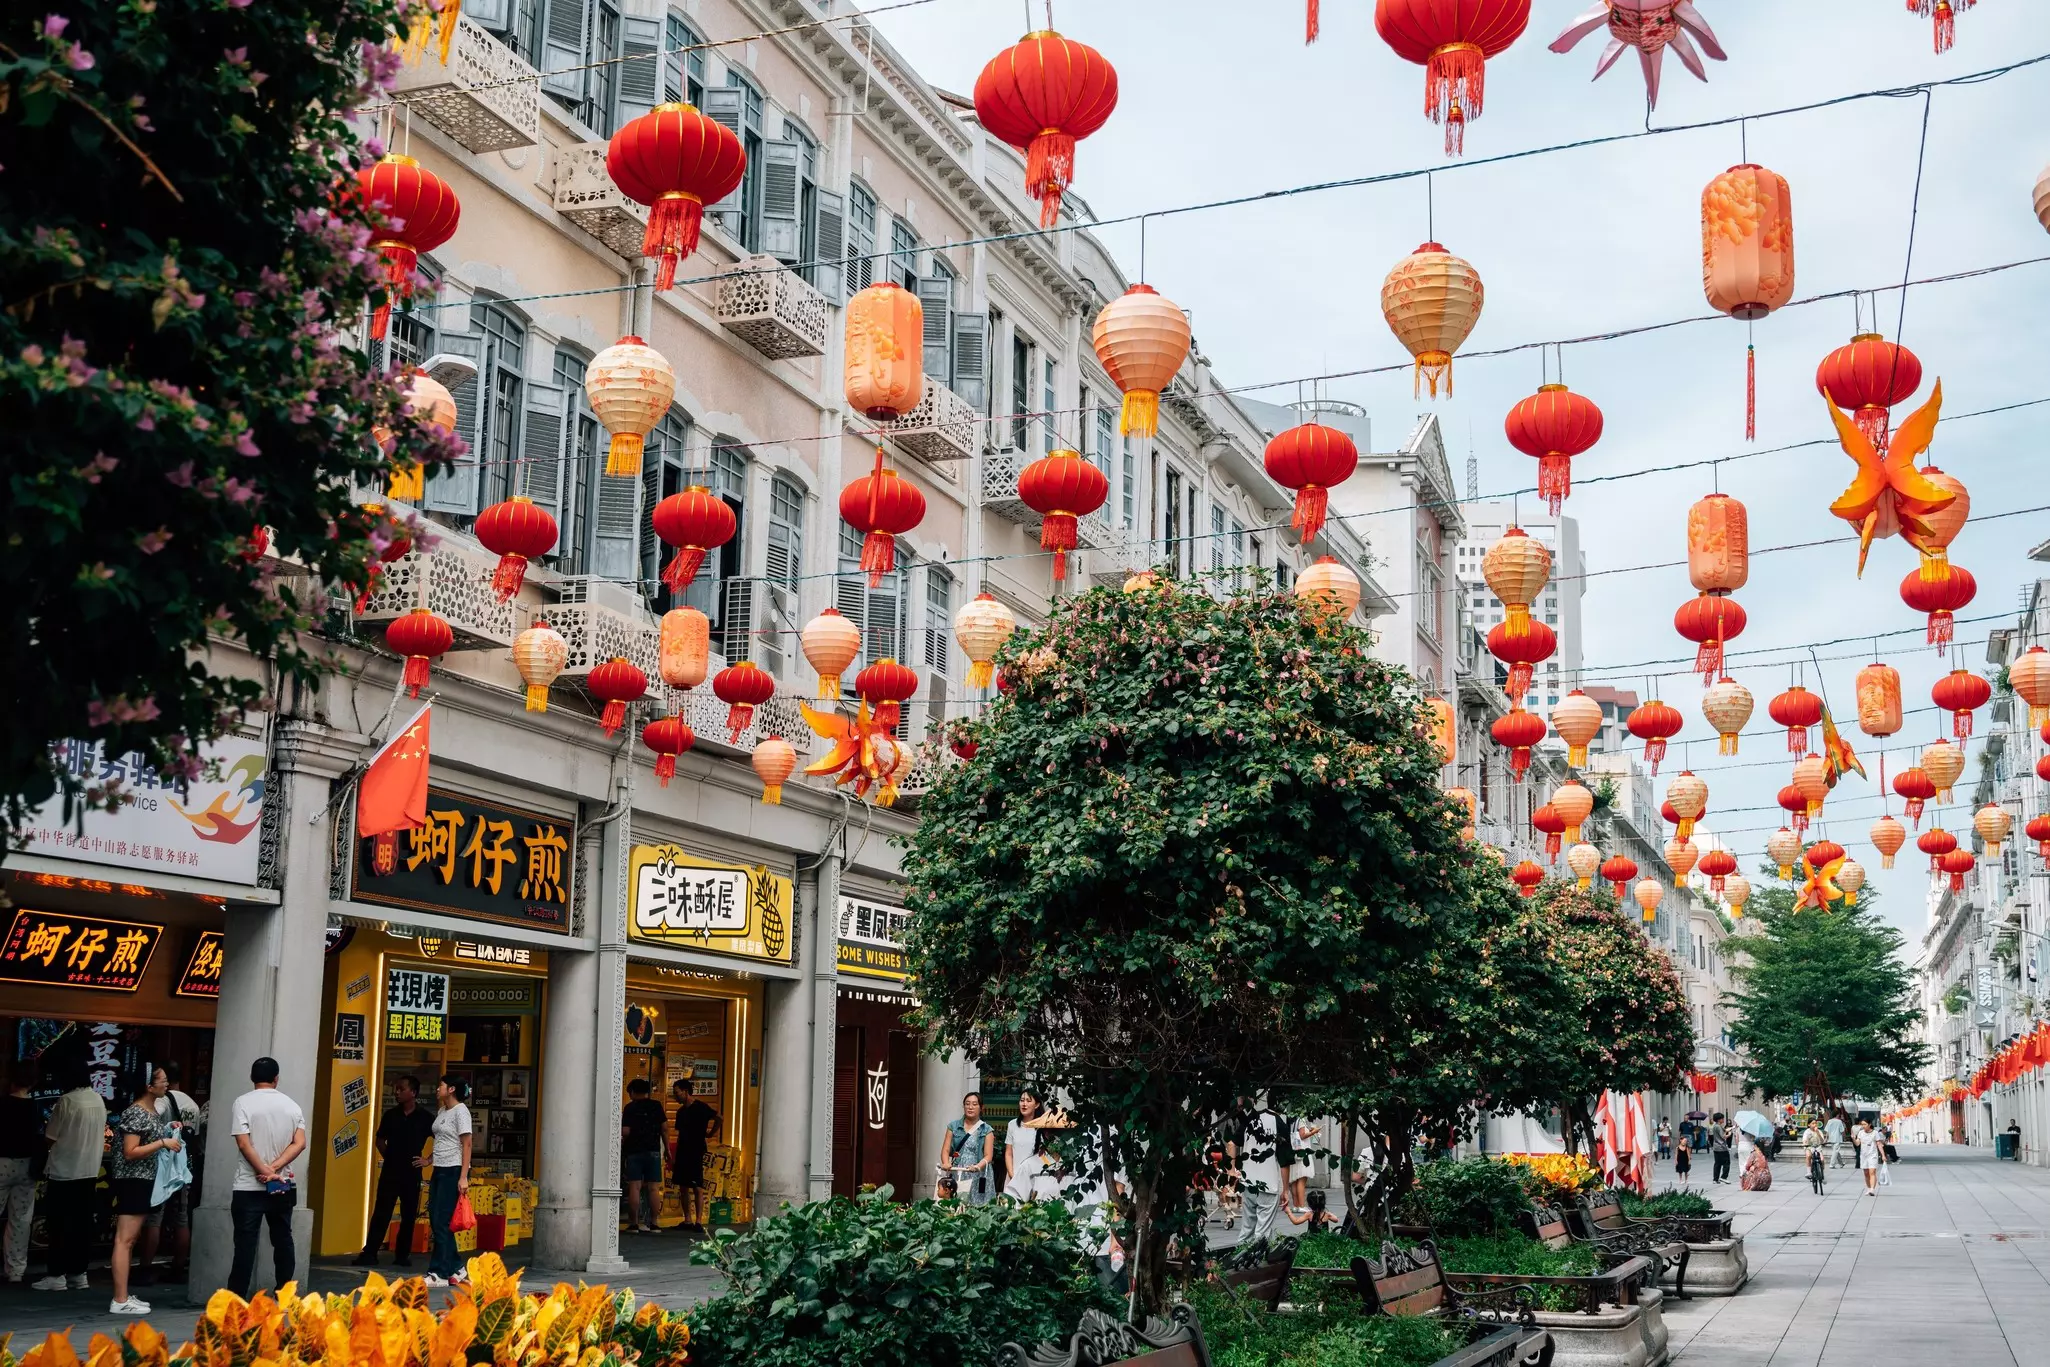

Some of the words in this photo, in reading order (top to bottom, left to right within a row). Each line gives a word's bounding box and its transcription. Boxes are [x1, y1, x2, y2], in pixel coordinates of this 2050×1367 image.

[407, 810, 568, 904] 蚵仔煎
[649, 877, 735, 924] 三味酥屋
[20, 922, 149, 973] 蚵仔煎
[866, 949, 901, 969] WISHES
[388, 1013, 442, 1041] 黑凤梨酥
